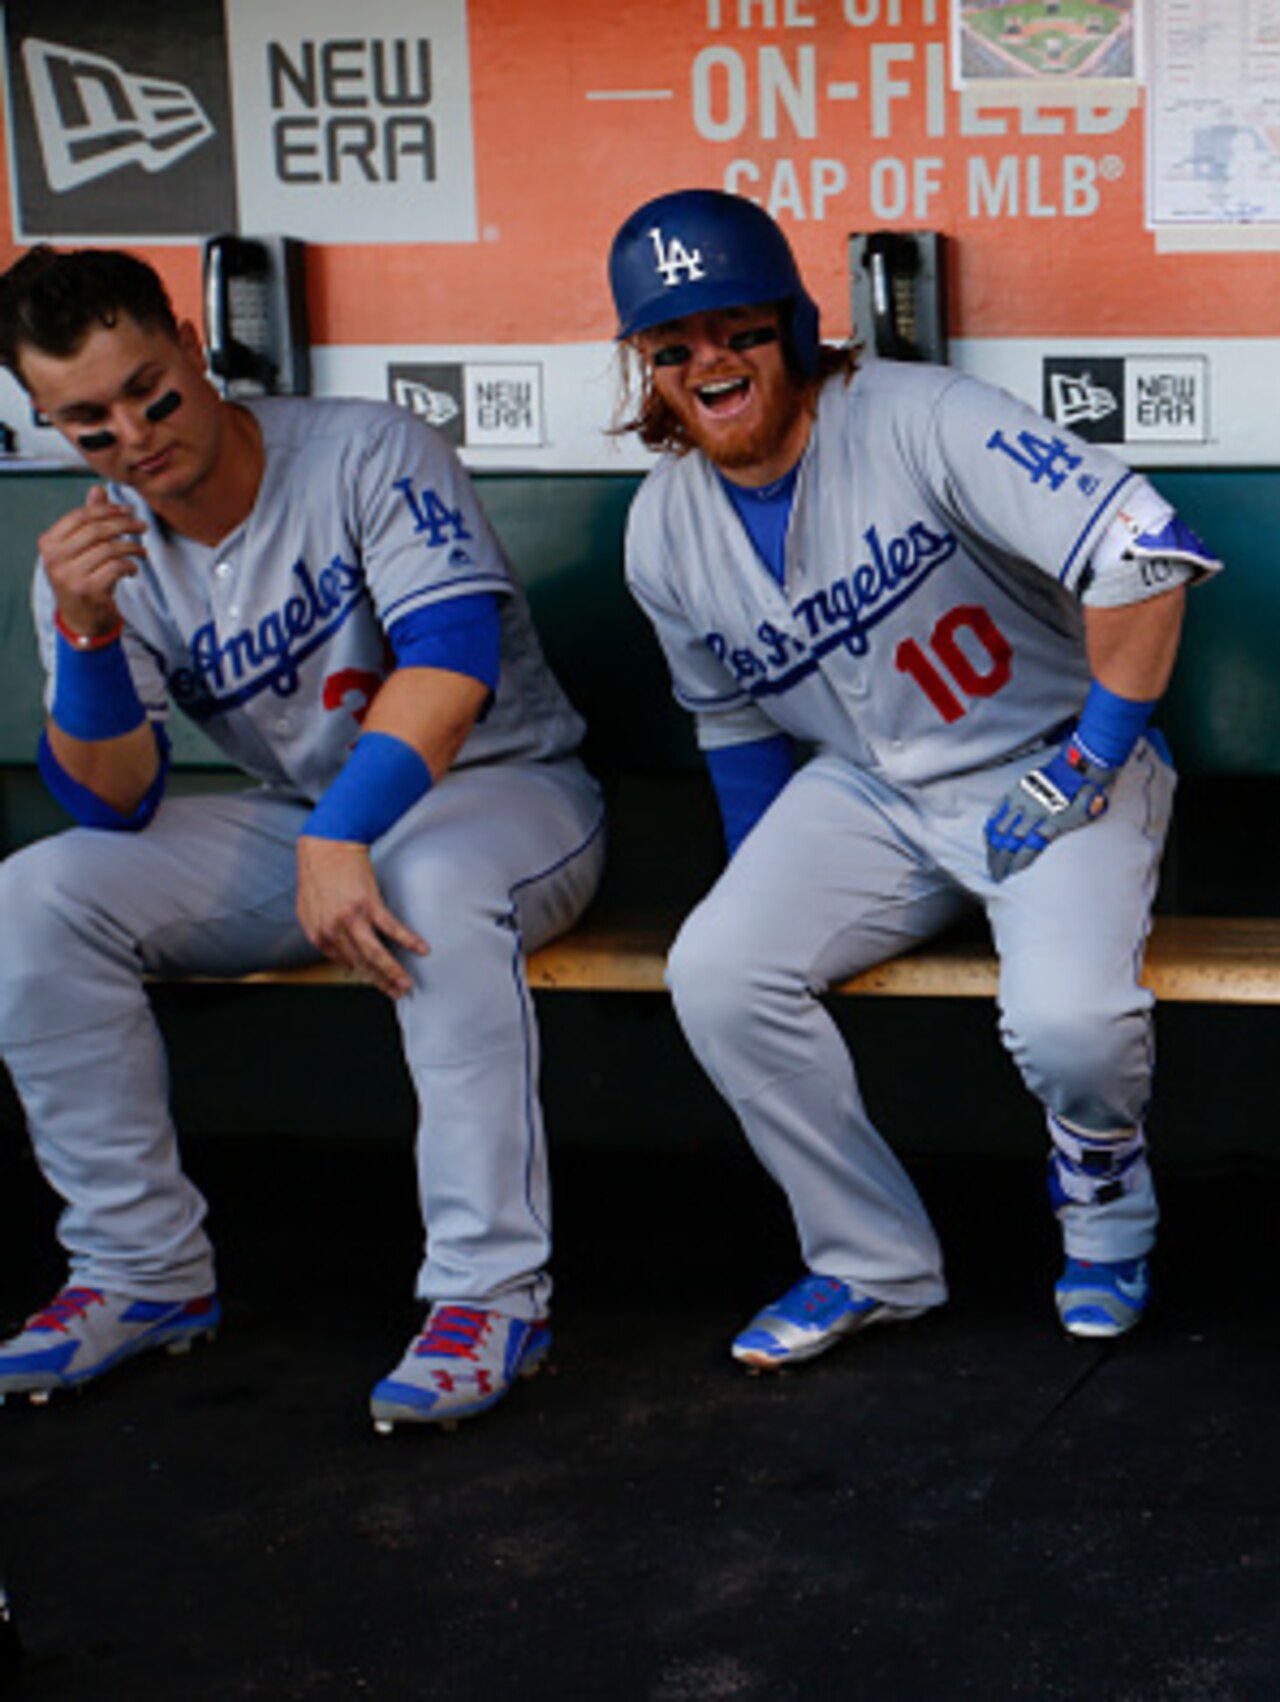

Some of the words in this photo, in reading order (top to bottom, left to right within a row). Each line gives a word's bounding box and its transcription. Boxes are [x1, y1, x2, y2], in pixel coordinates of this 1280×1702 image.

[267, 38, 433, 110] NEW
[273, 115, 436, 184] ERA
[870, 157, 943, 220] OF
[648, 228, 706, 286] LA
[477, 381, 531, 402] NEW
[1137, 375, 1195, 398] NEW
[1137, 400, 1195, 426] ERA
[478, 407, 531, 430] ERA
[986, 431, 1083, 491] LA
[392, 478, 473, 548] LA
[189, 555, 366, 698] Angeles
[895, 605, 1013, 724] 10
